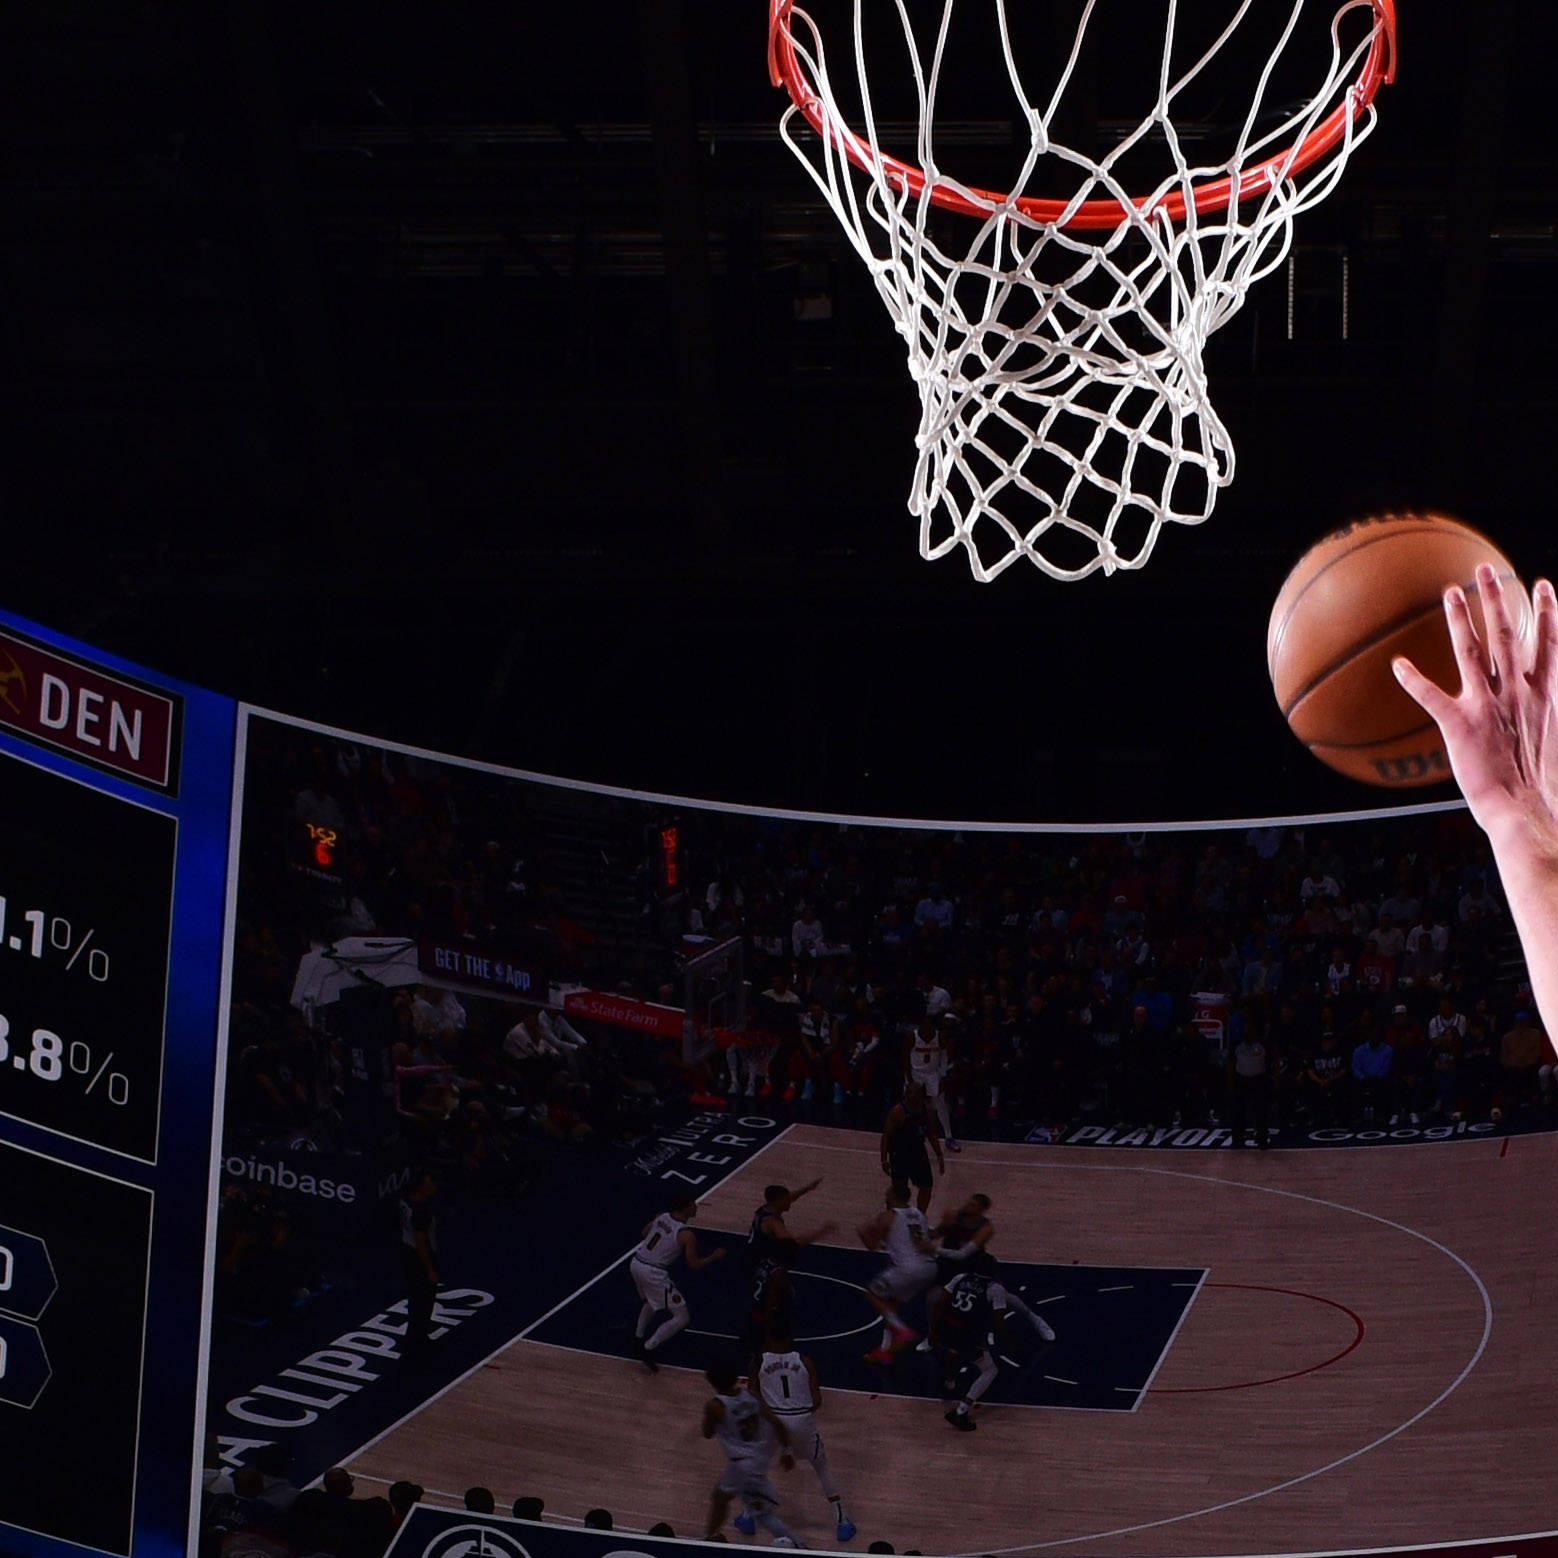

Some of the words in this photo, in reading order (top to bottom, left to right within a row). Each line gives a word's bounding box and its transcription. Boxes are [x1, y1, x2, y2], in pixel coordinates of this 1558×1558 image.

[39, 673, 142, 761] DEN
[660, 1116, 777, 1184] ZERO
[1308, 1119, 1497, 1142] Google
[221, 1155, 357, 1203] oinbase
[951, 1290, 978, 1312] 55
